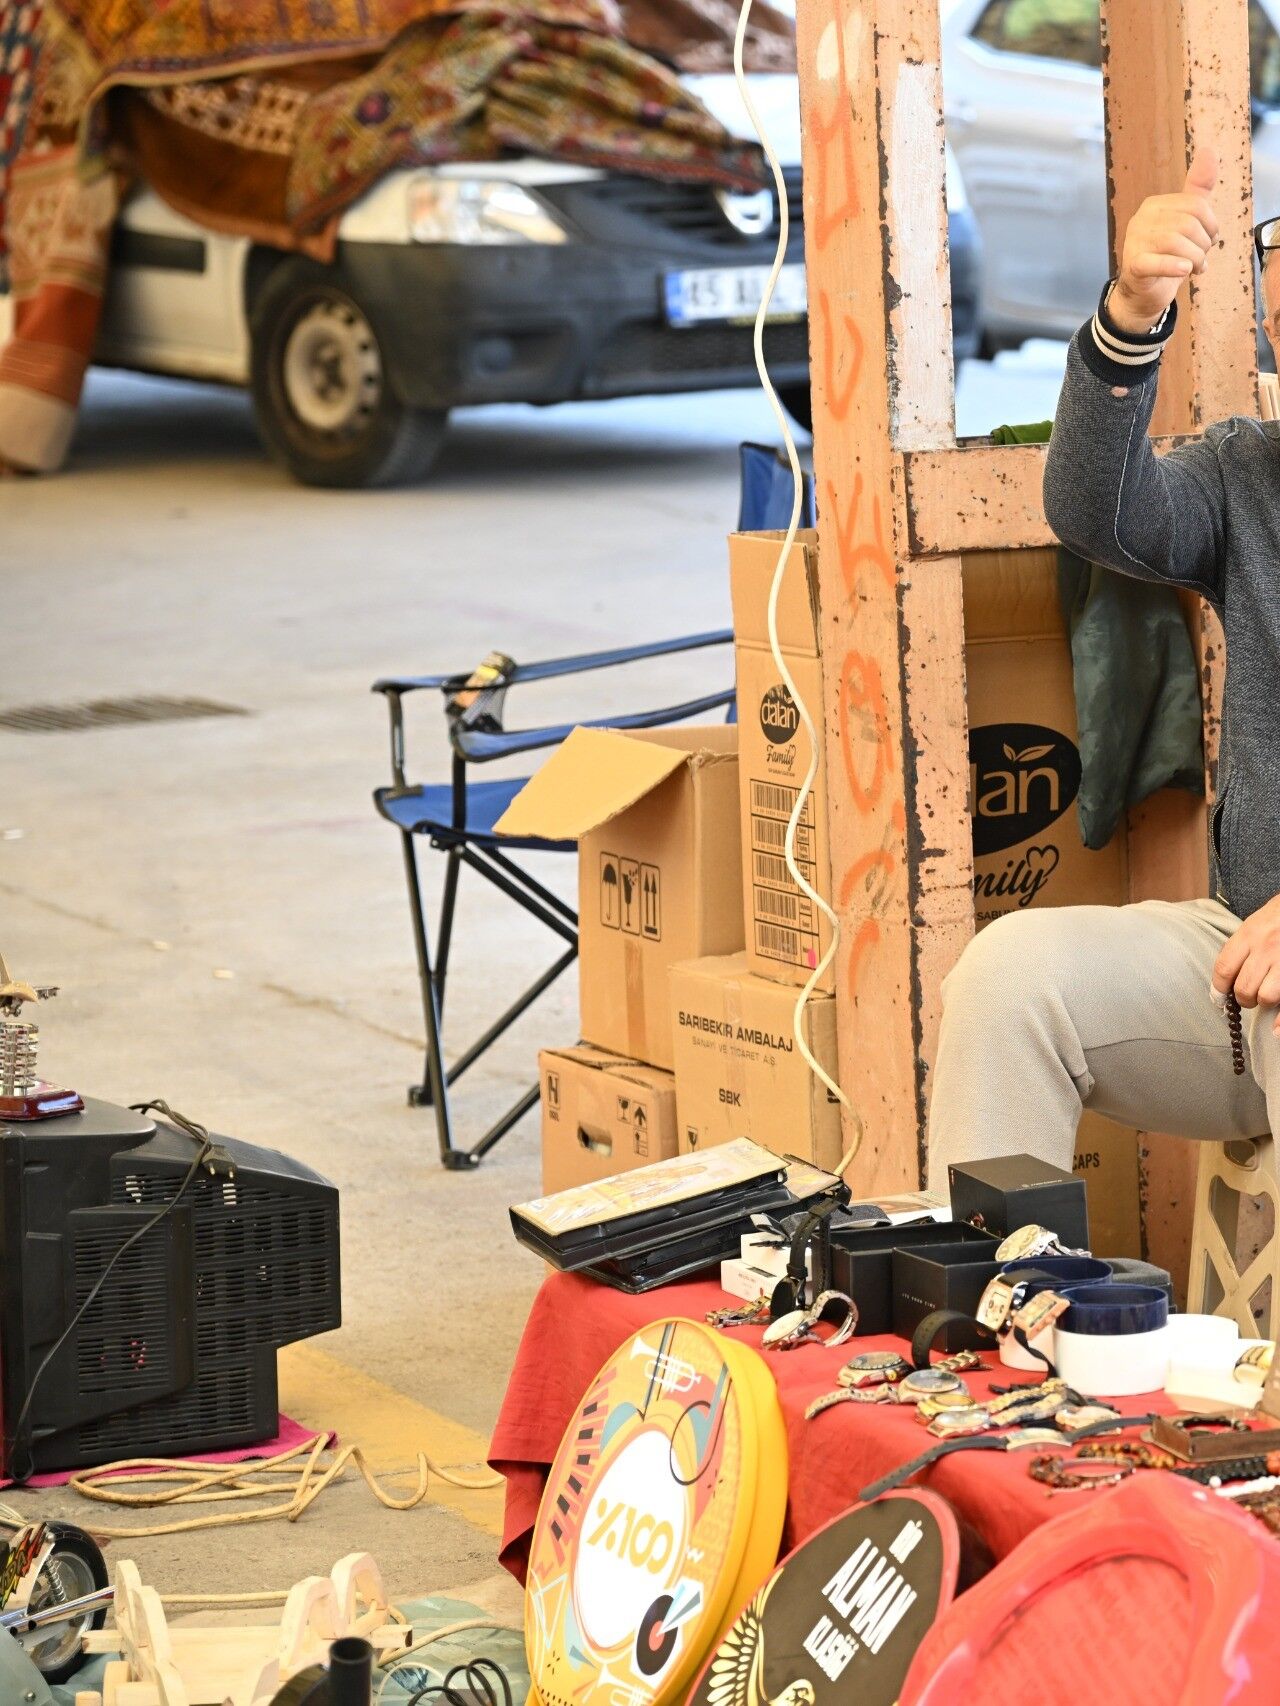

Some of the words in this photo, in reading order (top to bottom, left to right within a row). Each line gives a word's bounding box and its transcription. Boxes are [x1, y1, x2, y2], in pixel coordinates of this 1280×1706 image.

[761, 698, 797, 729] dalan
[766, 744, 797, 771] Family
[969, 762, 1060, 818] lan
[736, 1026, 793, 1053] AMBALAJ
[718, 1088, 742, 1107] SBK
[821, 1537, 917, 1655] ALMAN
